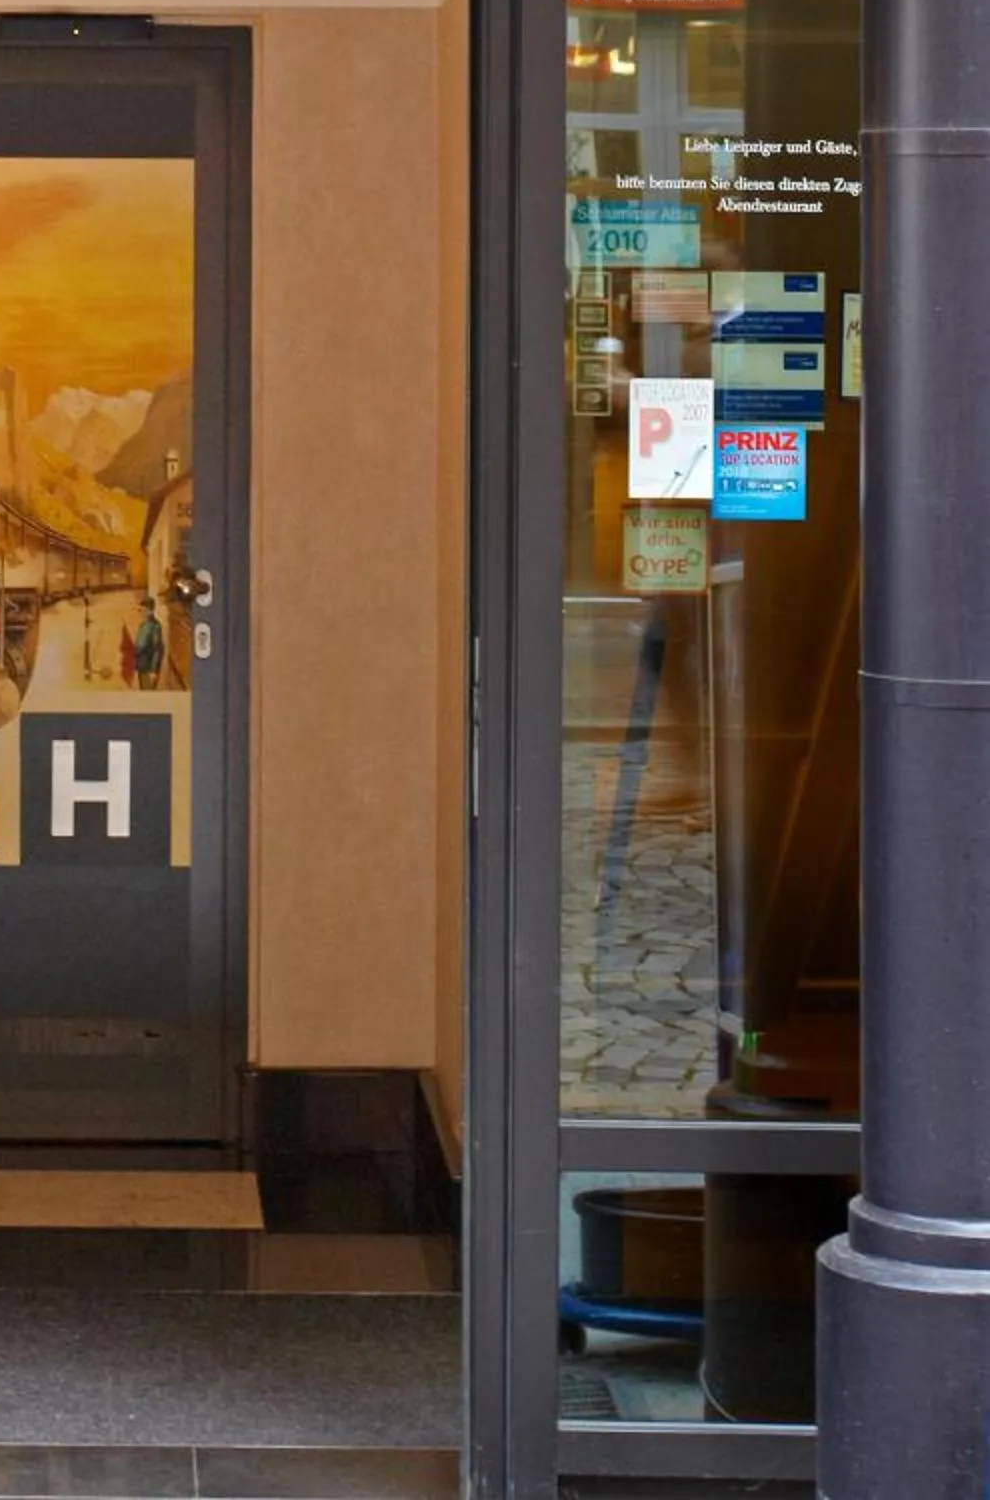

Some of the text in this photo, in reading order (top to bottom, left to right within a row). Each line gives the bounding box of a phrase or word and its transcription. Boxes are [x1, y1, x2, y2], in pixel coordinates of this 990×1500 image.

[685, 138, 859, 157] Liebe Leipziger und Gäste,
[616, 174, 863, 197] bitte benutzen Sie diesen direkten Zug
[716, 198, 823, 214] Abendrestaurant
[588, 229, 648, 252] 2010
[639, 407, 672, 459] P
[718, 431, 798, 451] PRINZ
[629, 514, 701, 529] Wir sind
[630, 554, 689, 578] QYPE
[50, 739, 132, 838] H
